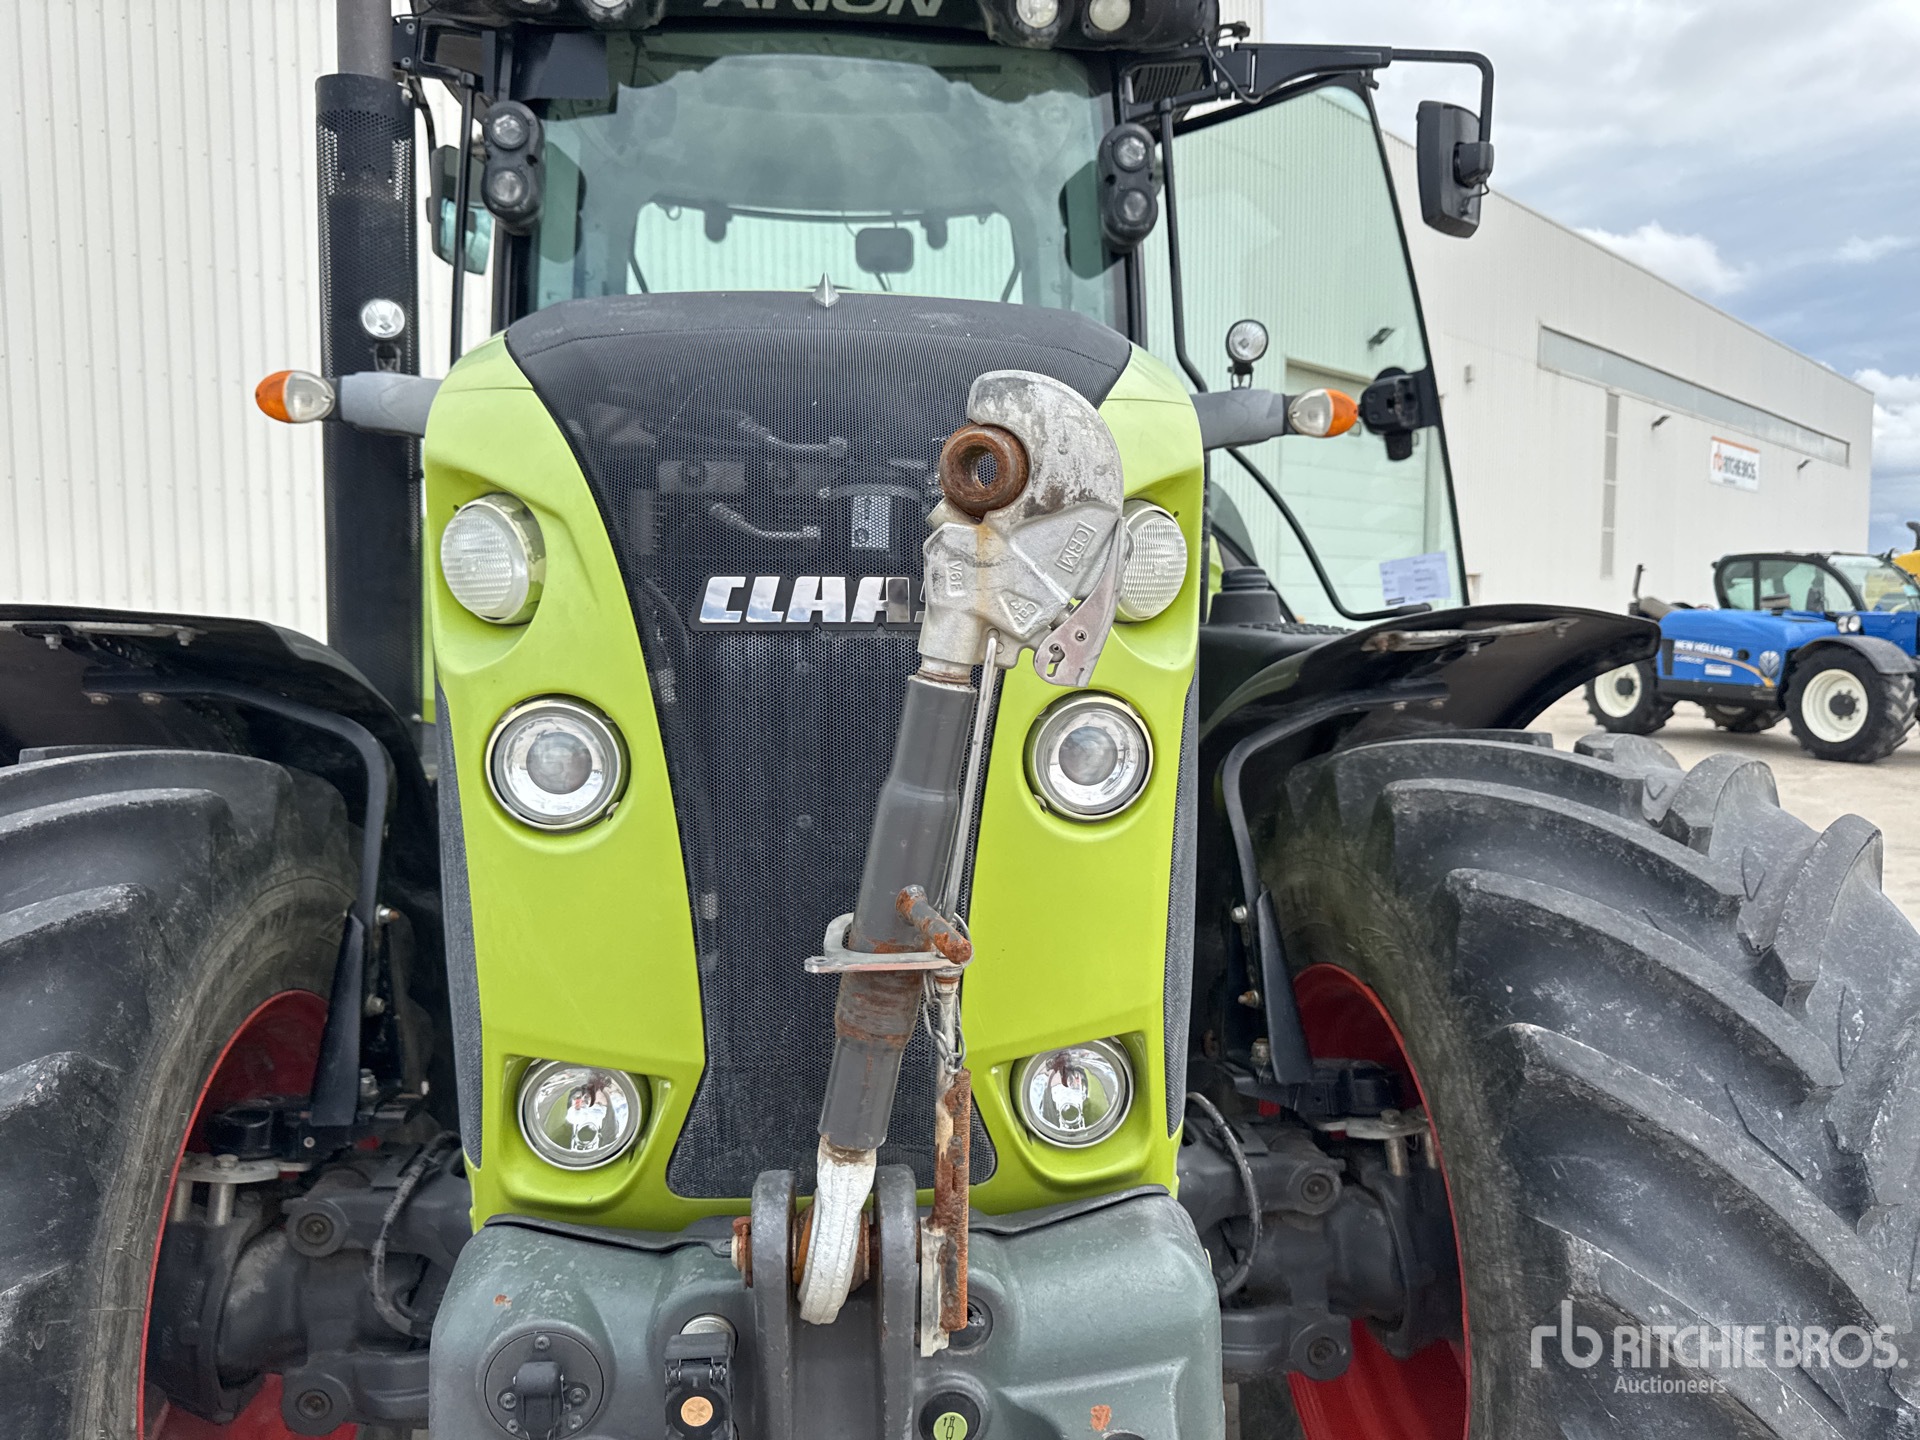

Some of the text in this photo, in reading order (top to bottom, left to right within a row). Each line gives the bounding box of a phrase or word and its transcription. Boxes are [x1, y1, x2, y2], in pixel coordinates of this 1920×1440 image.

[1060, 528, 1089, 570] CBM
[699, 576, 925, 623] CLAA
[1013, 601, 1040, 624] Cat
